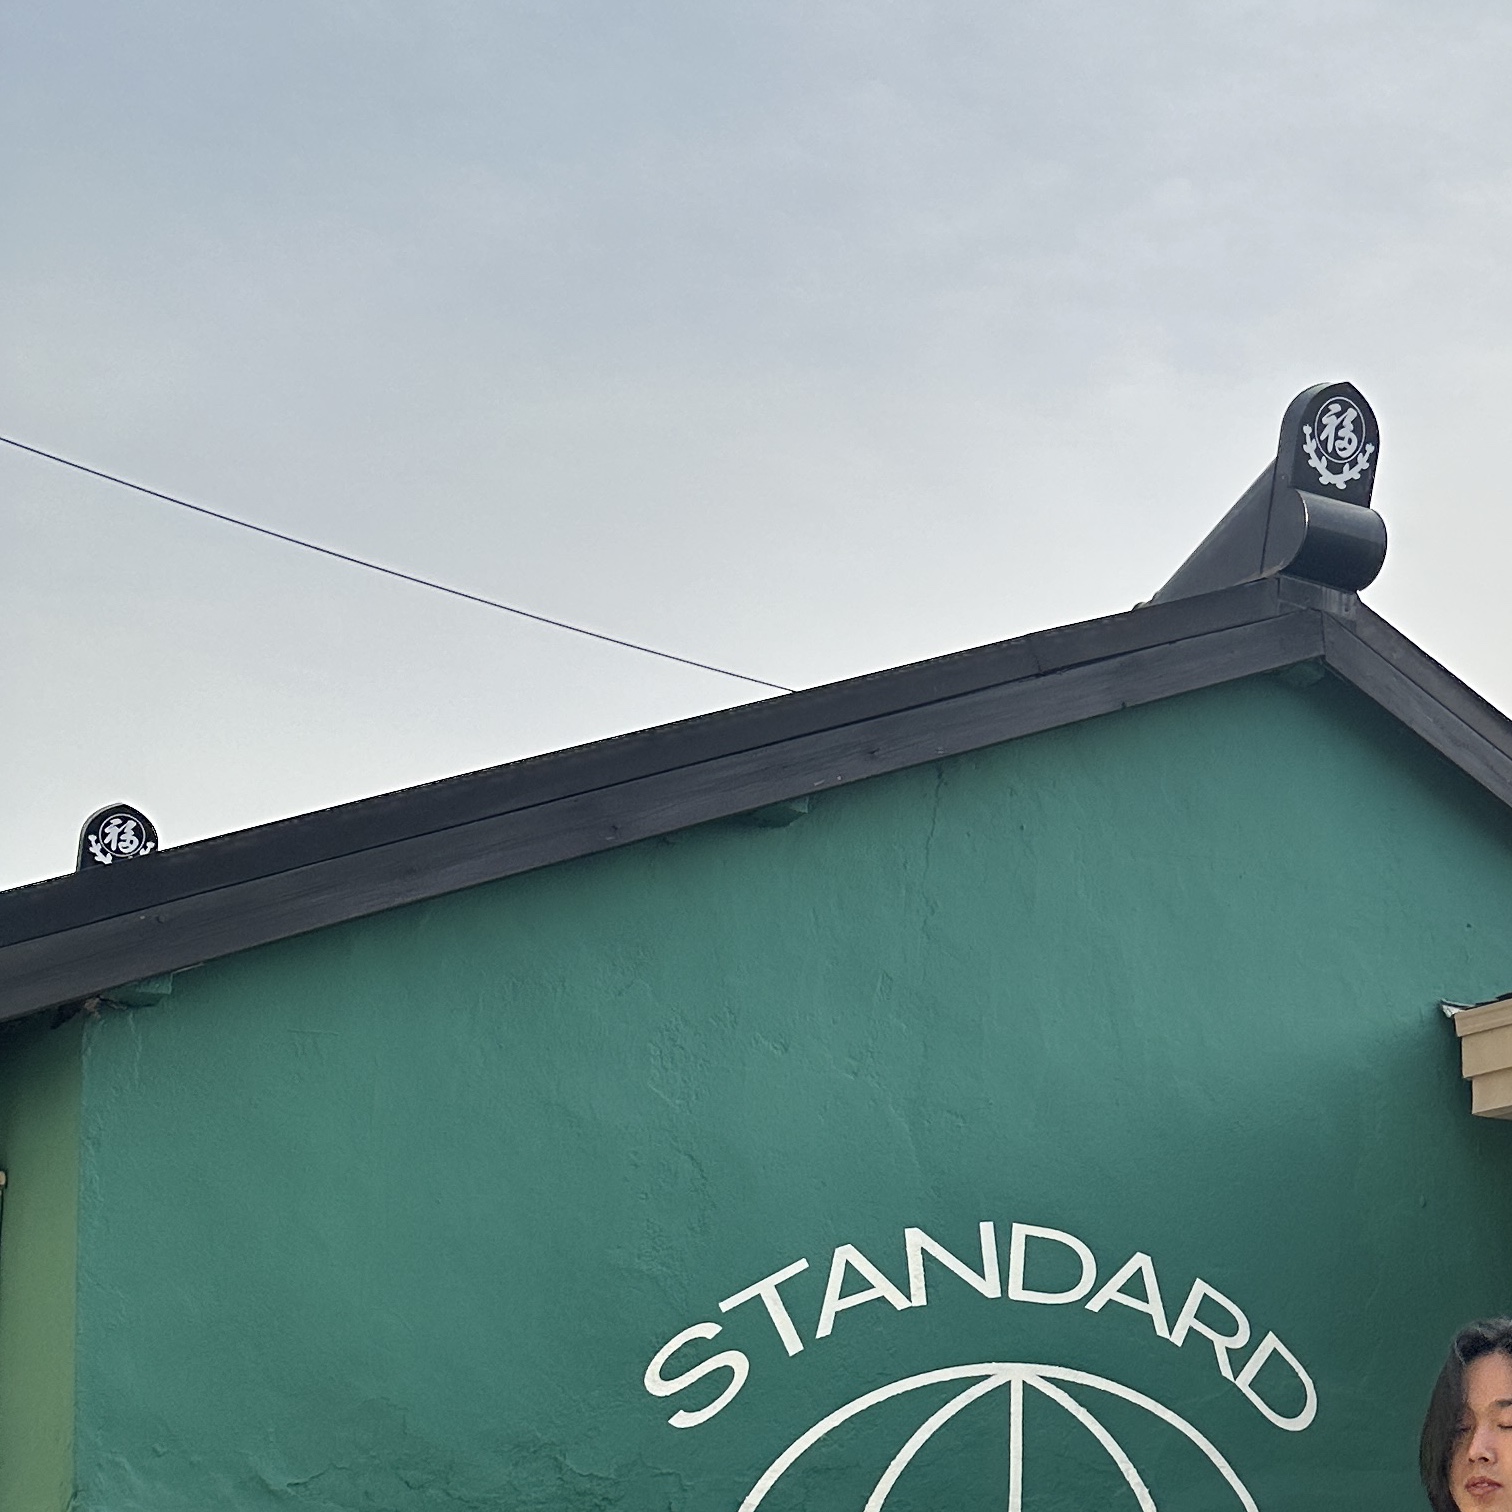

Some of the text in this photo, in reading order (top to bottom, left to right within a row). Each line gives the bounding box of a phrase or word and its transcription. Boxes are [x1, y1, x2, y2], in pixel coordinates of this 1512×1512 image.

[1320, 403, 1358, 459] 福
[103, 818, 140, 854] 福
[643, 1221, 1318, 1432] STANDARD
